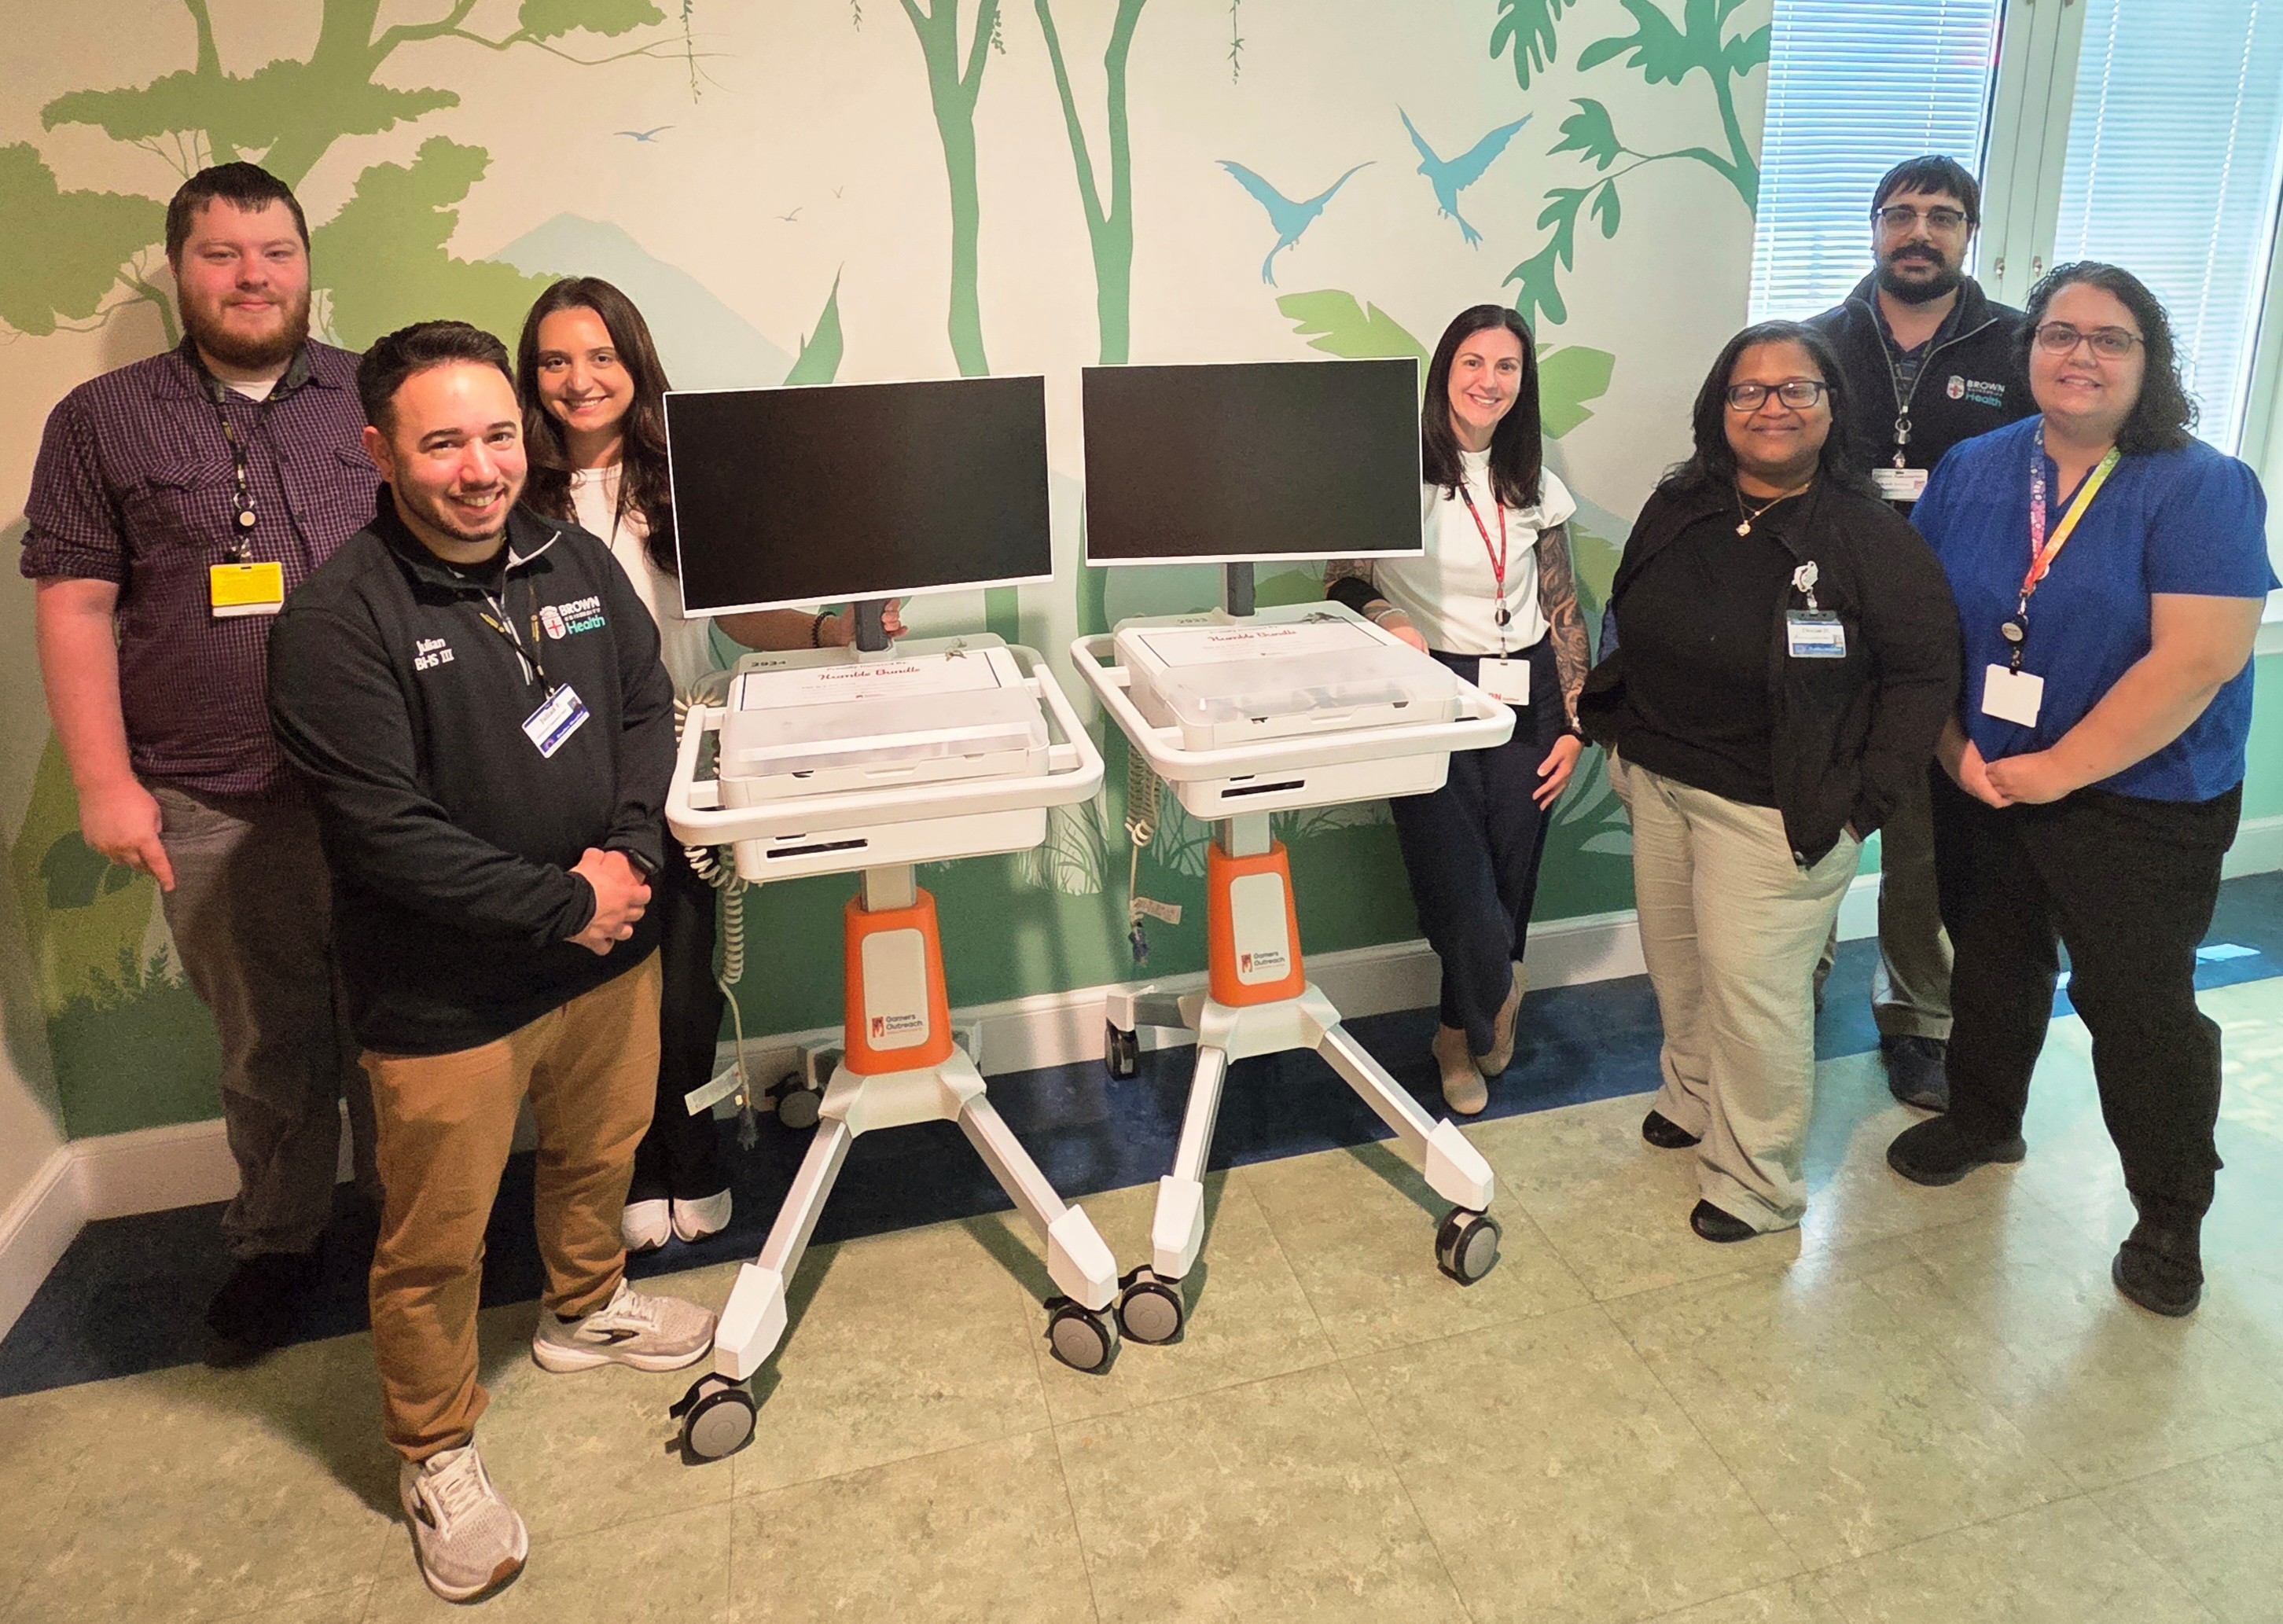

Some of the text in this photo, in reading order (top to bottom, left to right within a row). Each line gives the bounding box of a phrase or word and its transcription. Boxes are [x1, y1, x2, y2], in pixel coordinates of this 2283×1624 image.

[1966, 380, 2005, 392] BROWN
[1965, 392, 2002, 407] Health
[558, 595, 601, 617] BROWN
[565, 614, 606, 635] Health
[416, 638, 447, 656] Julian
[414, 648, 455, 671] BHS III
[818, 667, 921, 681] Humble Bundle
[886, 1020, 923, 1030] Outreach
